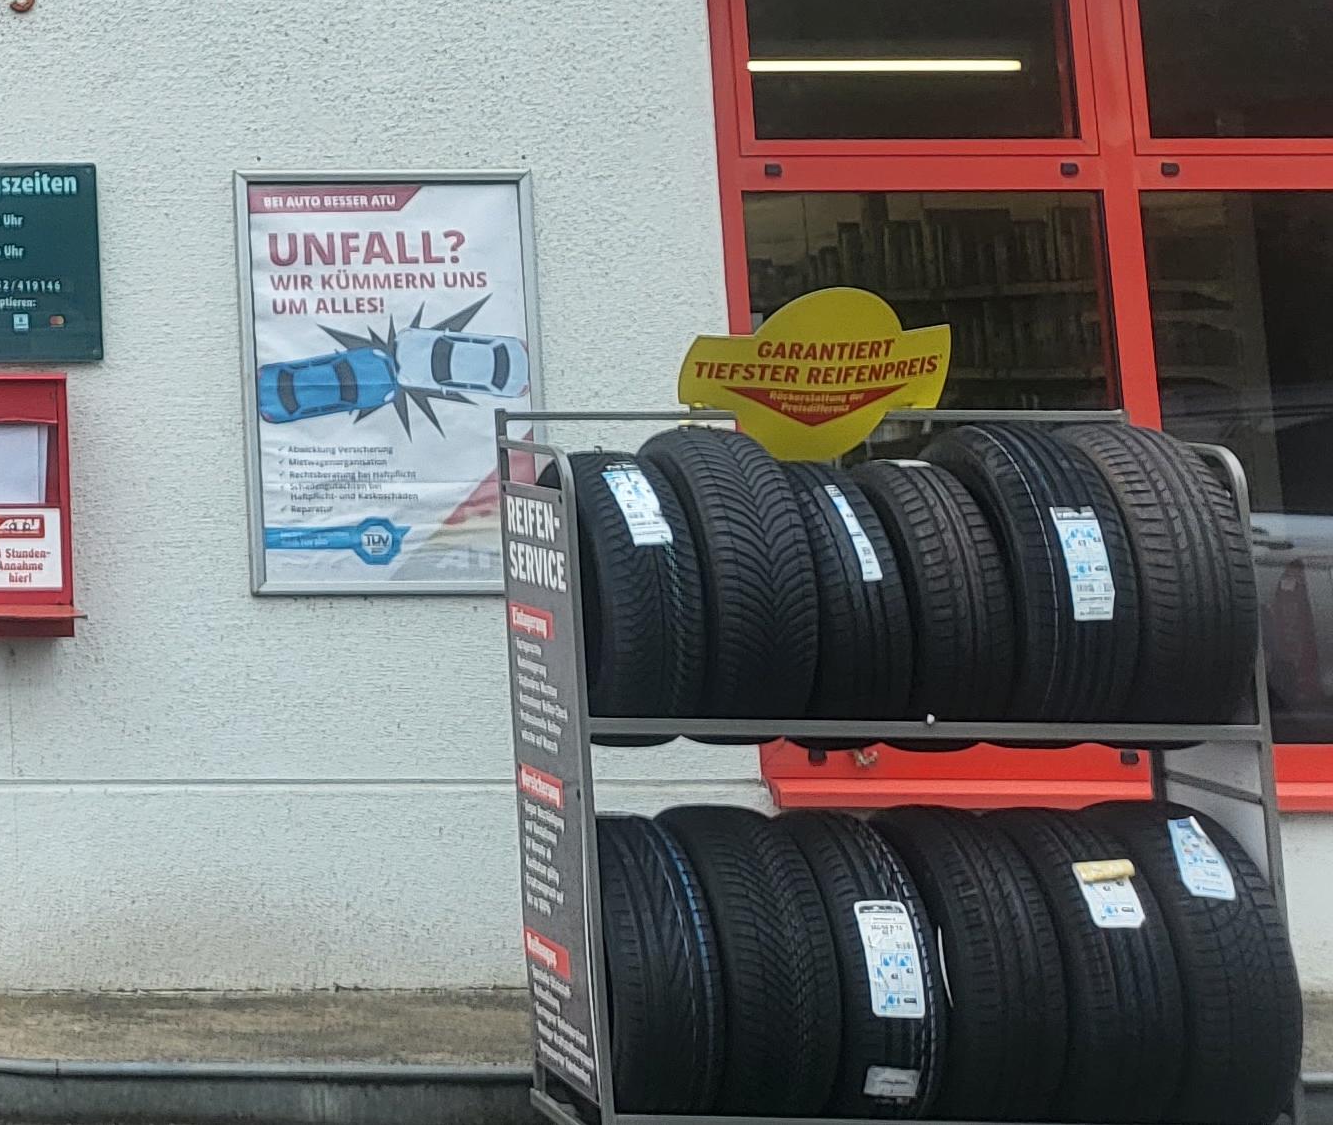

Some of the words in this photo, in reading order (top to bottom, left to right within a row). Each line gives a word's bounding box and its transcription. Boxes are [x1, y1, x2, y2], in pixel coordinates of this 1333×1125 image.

[264, 197, 283, 208] BEI
[286, 196, 320, 207] AUTO
[324, 195, 368, 207] BESSER
[371, 195, 396, 206] ATU
[3, 213, 23, 227] Uhr
[4, 244, 24, 258] Uhr
[268, 230, 466, 266] UNFALL?
[270, 274, 313, 290] WIR
[321, 269, 435, 290] KÜMMERN
[443, 272, 488, 288] UNS
[272, 298, 307, 315] UM
[315, 297, 385, 315] ALLES!
[758, 338, 895, 361] GARANTIERT
[695, 361, 800, 384] TIEFSTER
[338, 446, 393, 454] Versicherung
[291, 506, 333, 515] Reparatur
[506, 495, 560, 543] REIFEN-
[5, 548, 51, 559] Stunden-
[509, 541, 567, 592] SERVICE
[9, 572, 32, 583] hier!
